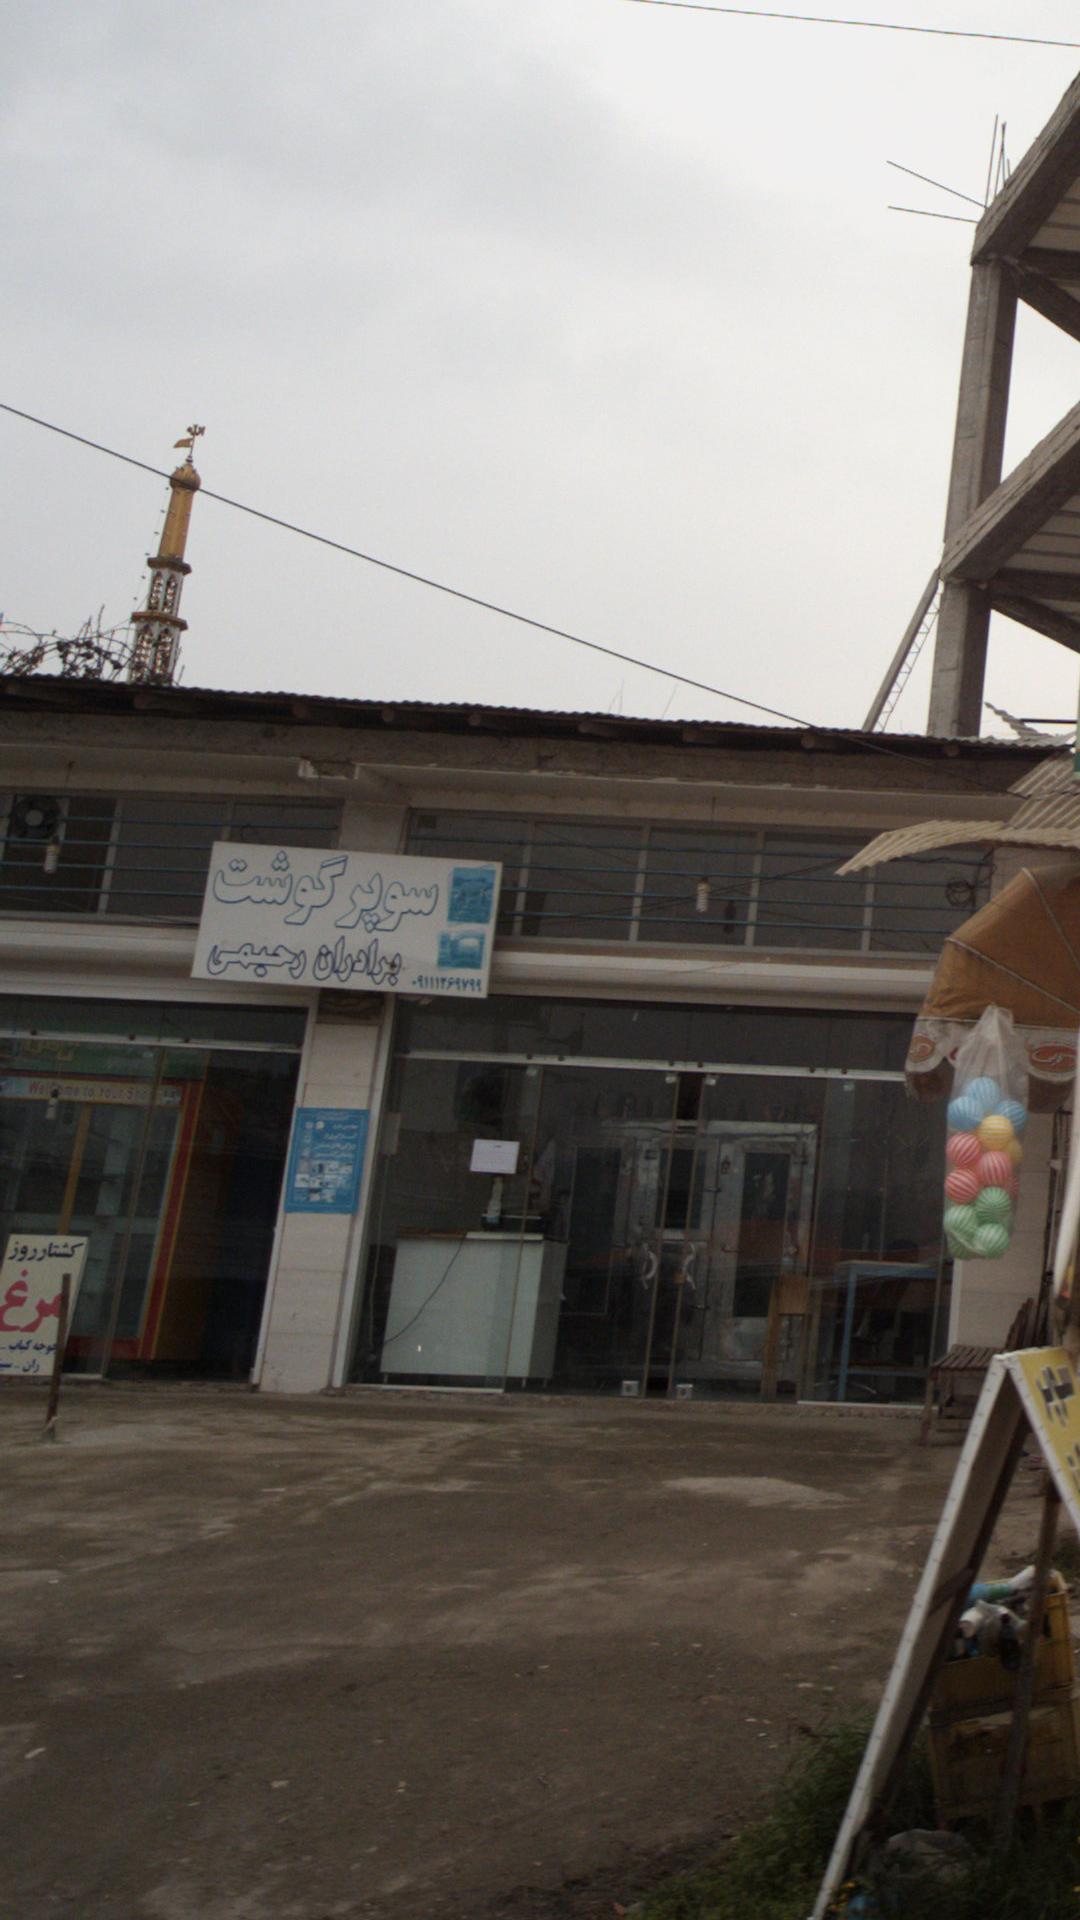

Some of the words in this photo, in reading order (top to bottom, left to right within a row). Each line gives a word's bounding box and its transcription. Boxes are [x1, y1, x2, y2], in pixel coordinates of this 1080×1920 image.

[212, 850, 349, 926] گوشت
[335, 872, 439, 933] سوپر
[206, 943, 307, 979] رحیمی
[312, 935, 402, 986] برادران
[8, 1241, 37, 1262] روز
[36, 1242, 85, 1262] کشتار
[0, 1269, 63, 1333] مرغ
